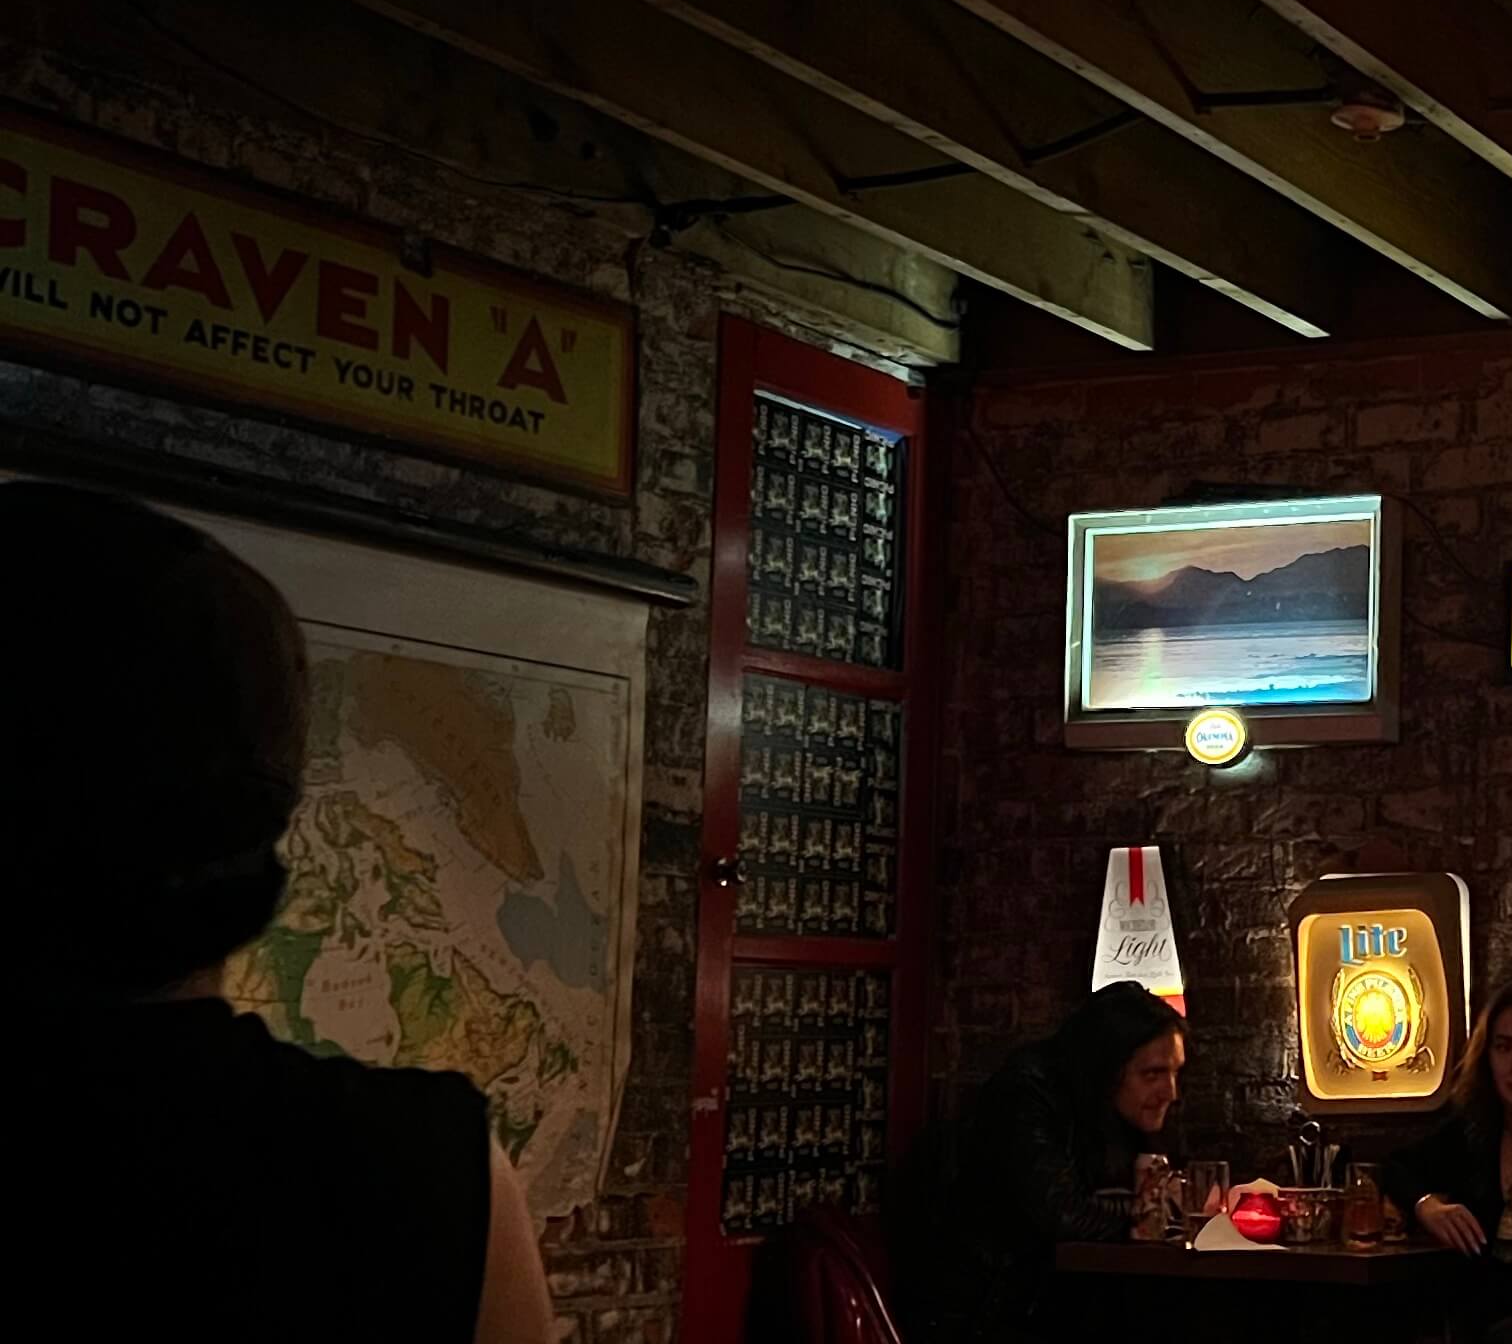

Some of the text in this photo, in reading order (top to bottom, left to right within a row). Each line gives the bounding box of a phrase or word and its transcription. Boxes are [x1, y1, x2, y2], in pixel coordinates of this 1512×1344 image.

[90, 290, 168, 336] NOT
[184, 318, 317, 374] AFFECT
[334, 357, 415, 403] YOUR
[430, 383, 546, 435] THROAT
[1108, 932, 1168, 967] Light
[1339, 923, 1408, 966] Lite
